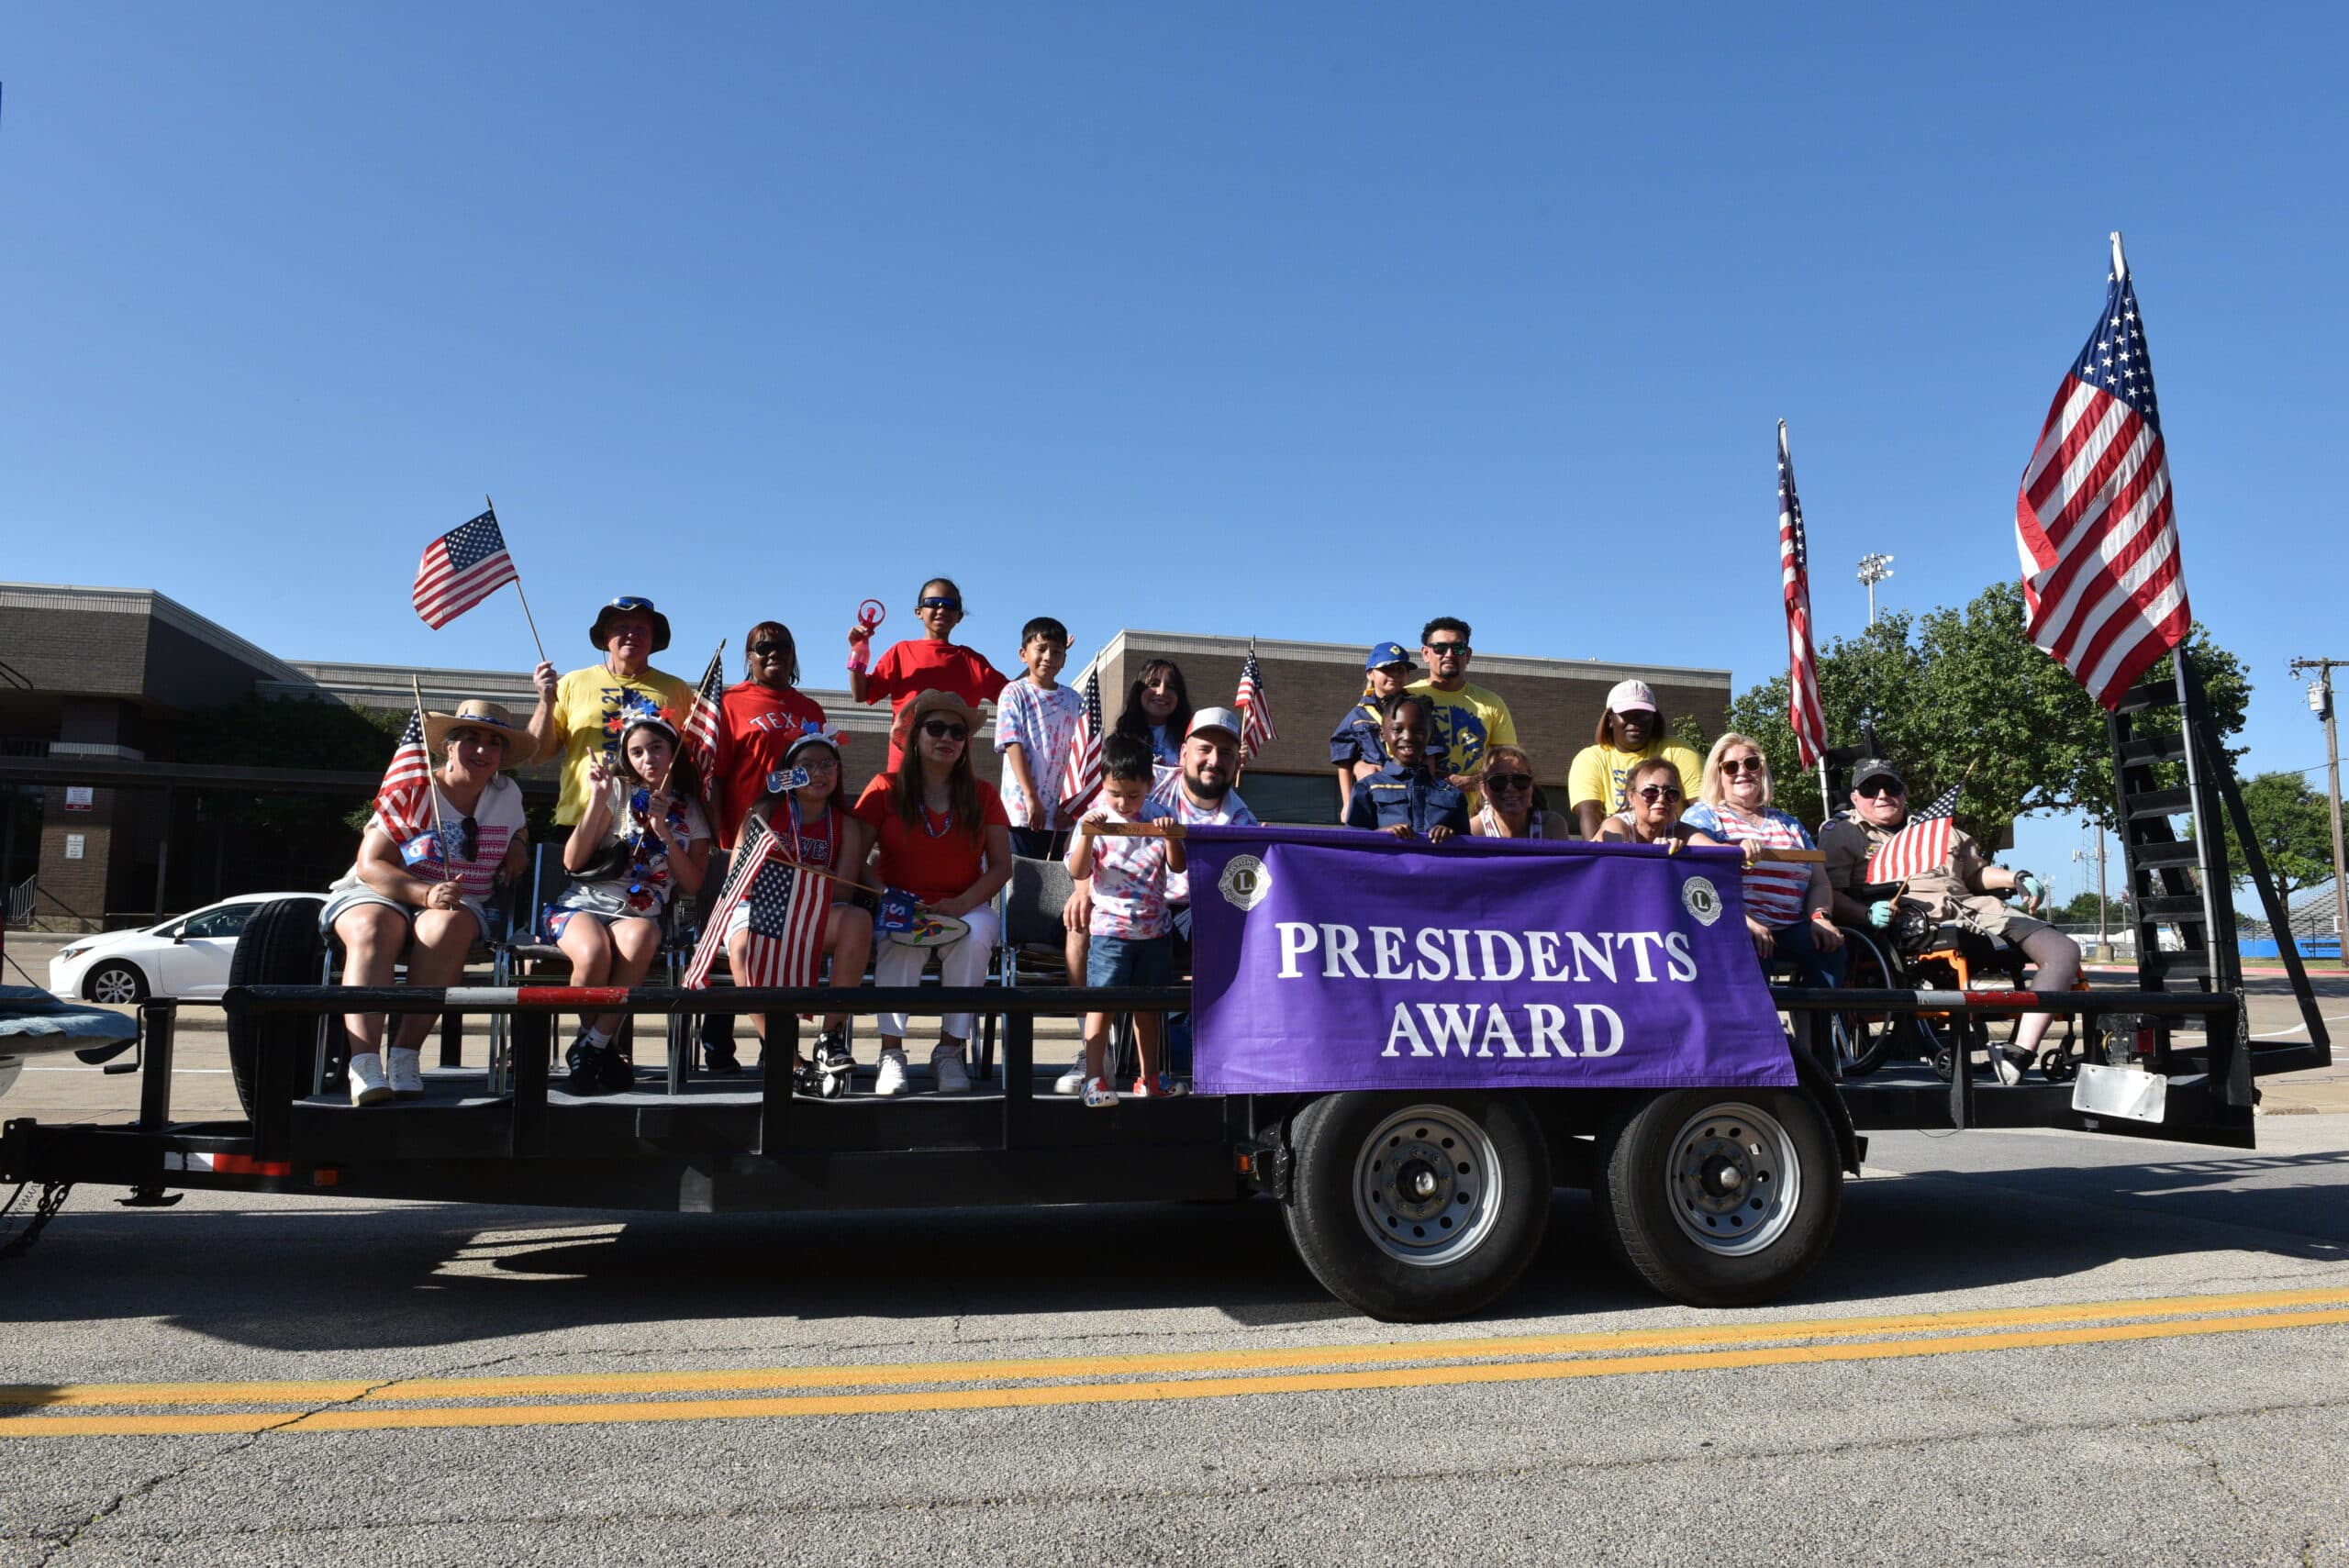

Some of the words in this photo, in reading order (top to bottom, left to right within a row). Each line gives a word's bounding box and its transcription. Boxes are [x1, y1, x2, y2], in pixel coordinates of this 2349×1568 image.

[601, 686, 621, 705] 21
[750, 712, 809, 732] TEXA
[1613, 769, 1627, 785] 21
[1239, 873, 1253, 891] L
[1695, 892, 1709, 909] L
[1275, 922, 1698, 984] PRESIDENTS
[1381, 1001, 1624, 1058] AWARD
